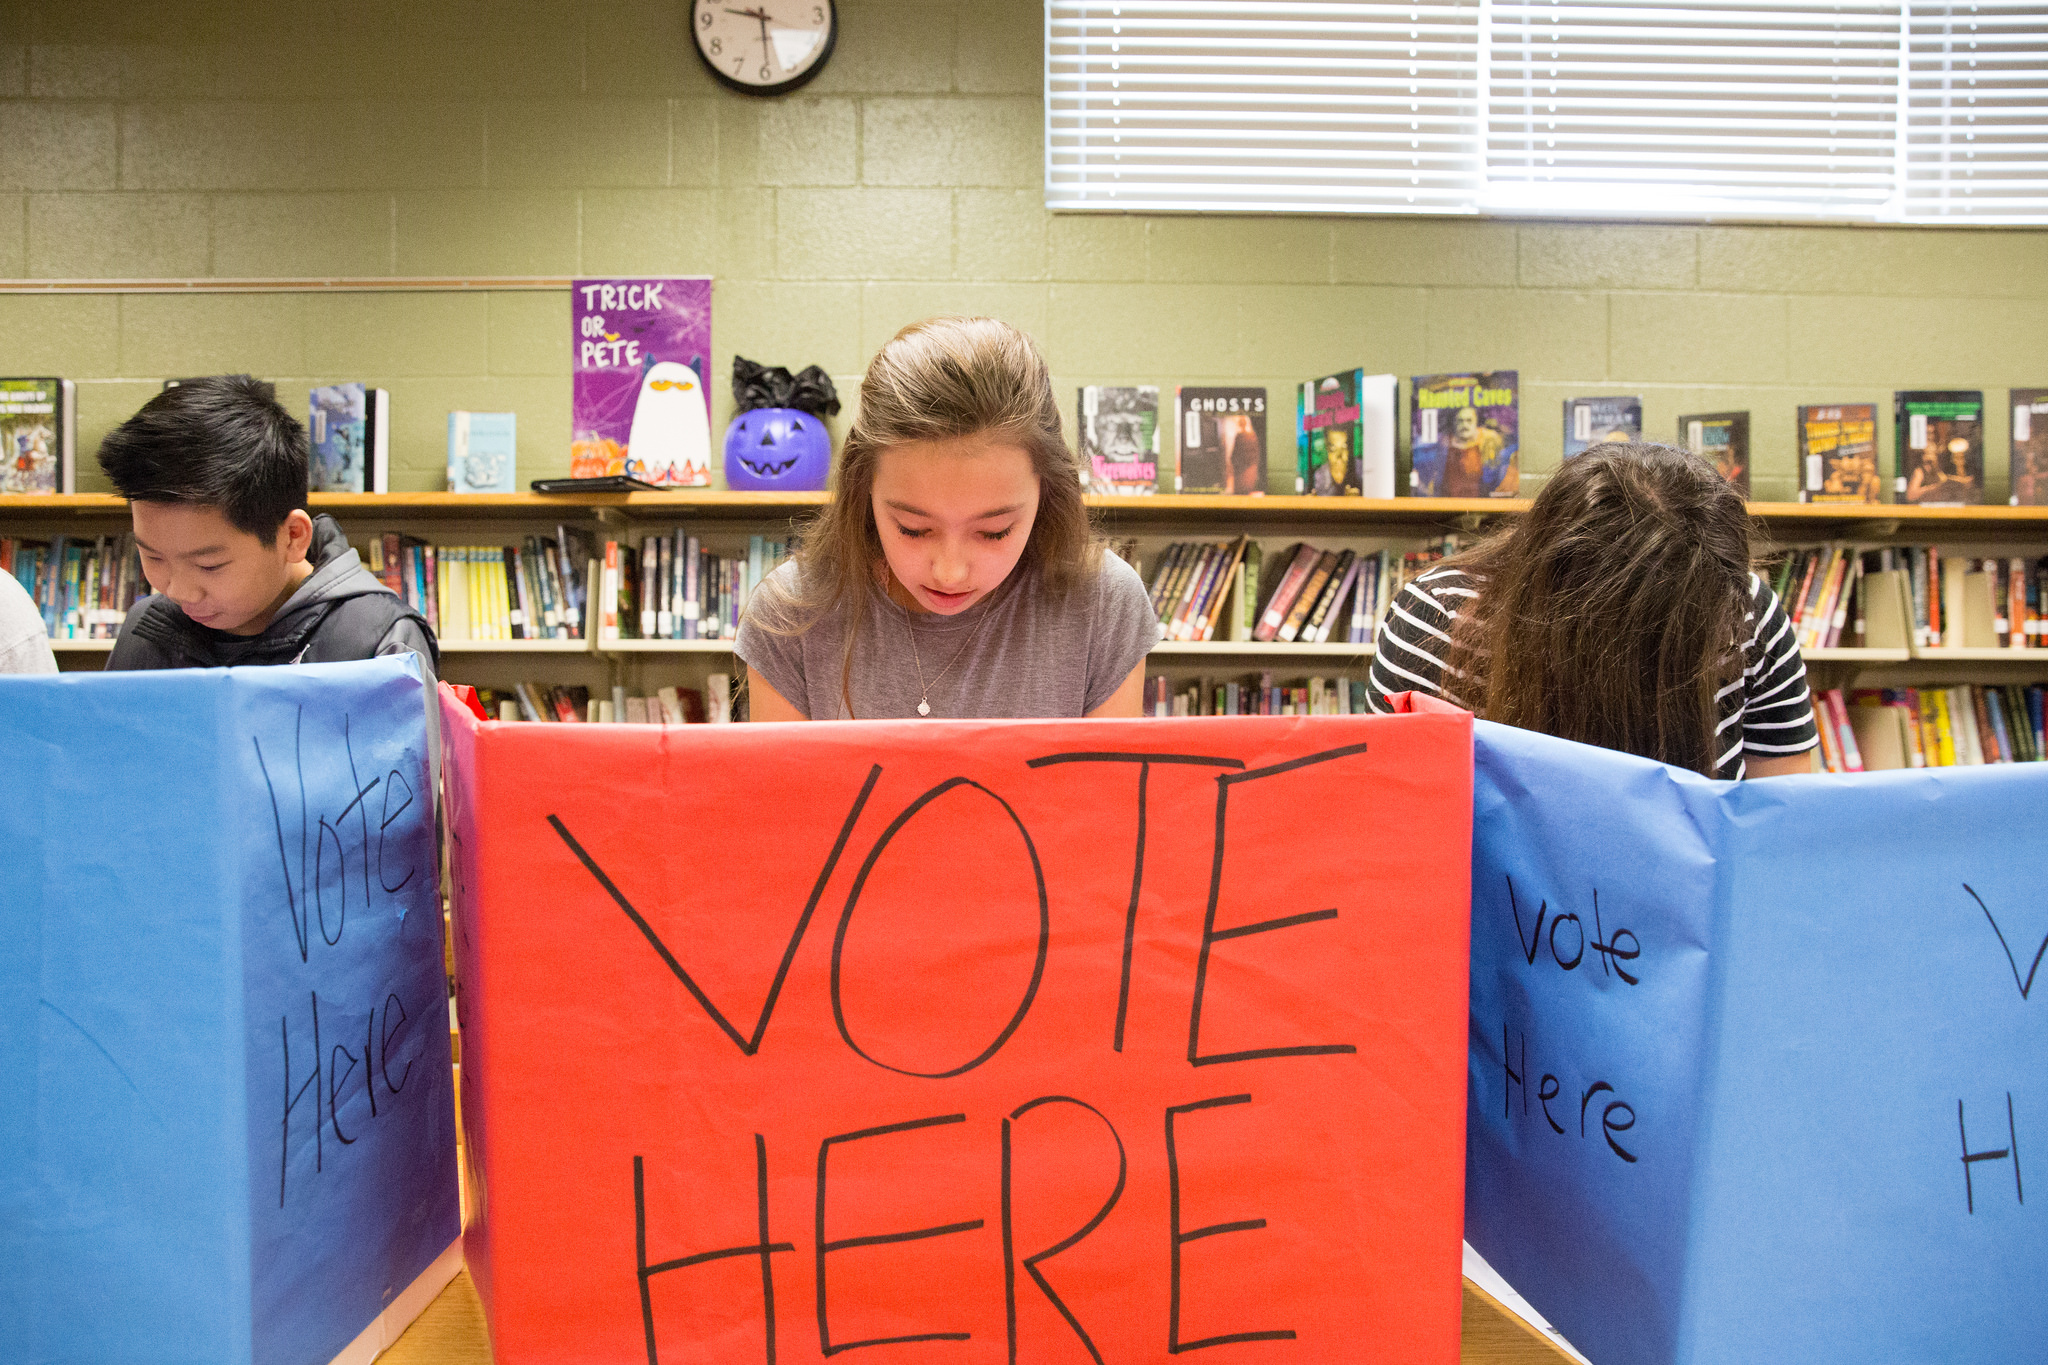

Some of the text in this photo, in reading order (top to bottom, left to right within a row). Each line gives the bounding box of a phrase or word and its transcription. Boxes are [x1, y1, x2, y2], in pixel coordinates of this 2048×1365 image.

[701, 12, 713, 31] 9
[812, 5, 824, 25] 3
[710, 36, 722, 56] 8
[733, 56, 744, 76] 7
[759, 63, 771, 81] 6
[580, 283, 663, 311] TRICK
[581, 315, 606, 338] OR
[581, 340, 642, 368] PETE
[1190, 397, 1265, 412] GHOSTS
[1418, 385, 1512, 409] Haunted Caves
[254, 704, 415, 963] Vote
[546, 743, 1367, 1078] VOTE
[1506, 874, 1641, 986] Vote
[280, 990, 413, 1209] Here
[1504, 1022, 1638, 1163] Here
[1958, 1090, 2024, 1216] H
[633, 1095, 1297, 1365] HERE
